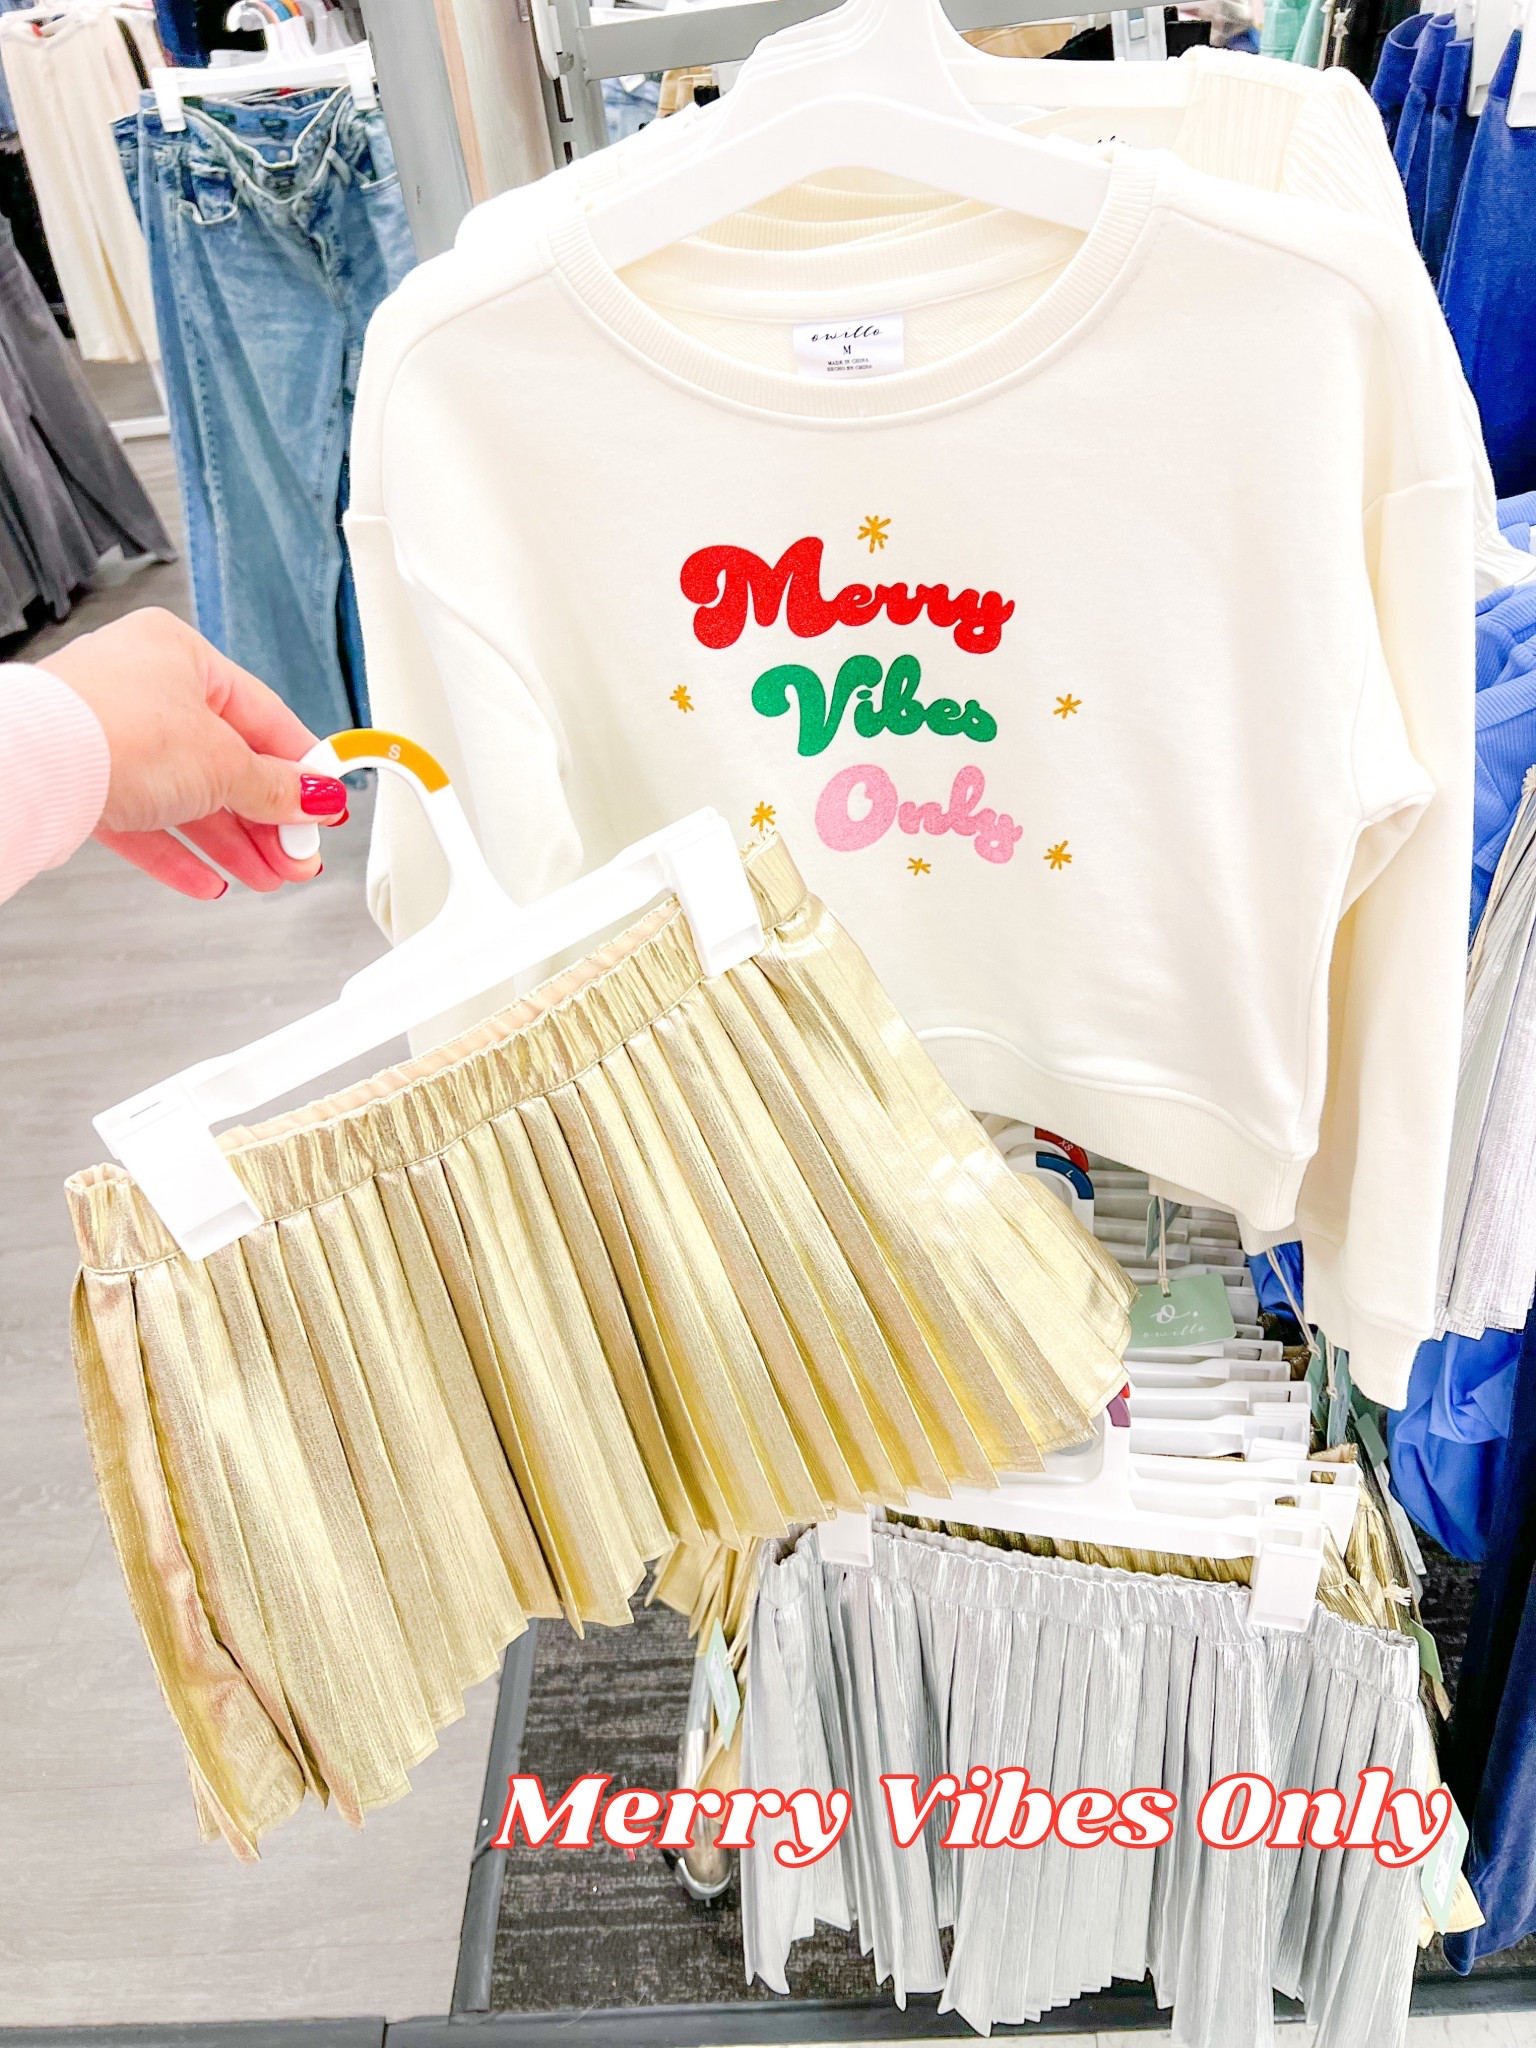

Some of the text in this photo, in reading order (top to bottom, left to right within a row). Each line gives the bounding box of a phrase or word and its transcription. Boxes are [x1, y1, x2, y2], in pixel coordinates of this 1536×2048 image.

[843, 345, 851, 355] M
[680, 536, 1016, 655] Merry
[751, 654, 998, 757] Vibes
[388, 744, 401, 760] S
[815, 763, 1024, 865] Only
[1059, 1140, 1074, 1151] XS
[1066, 1169, 1074, 1178] L
